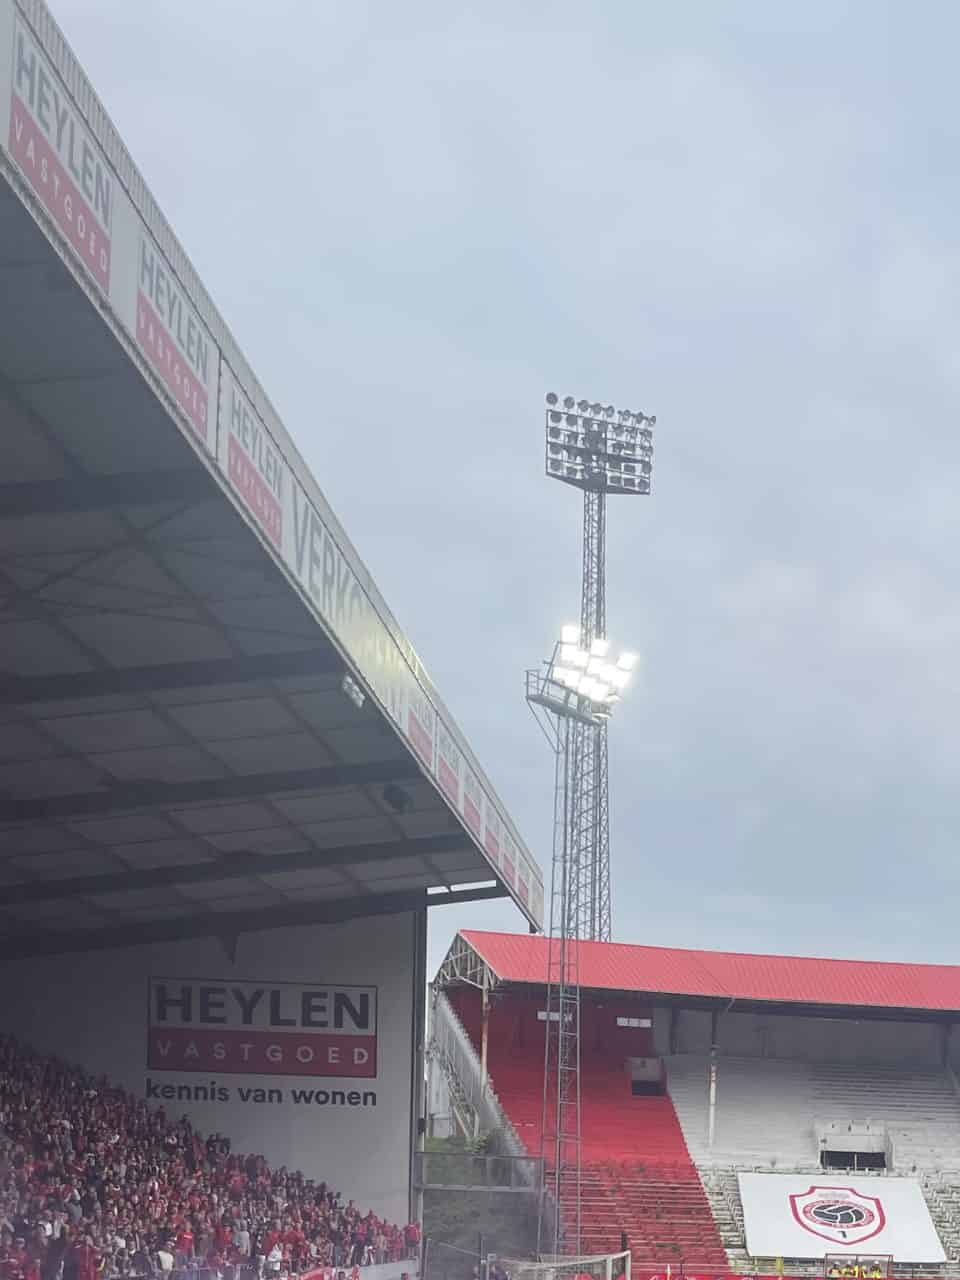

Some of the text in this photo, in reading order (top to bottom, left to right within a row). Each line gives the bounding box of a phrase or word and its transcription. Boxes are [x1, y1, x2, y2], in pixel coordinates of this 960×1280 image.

[16, 32, 112, 230] HEYLEN
[14, 116, 109, 275] VASTGOED
[140, 234, 209, 386] HEYLEN
[156, 984, 369, 1030] HEYLEN
[157, 1039, 369, 1065] VASTGOED
[146, 1077, 377, 1107] kennis van wonen
